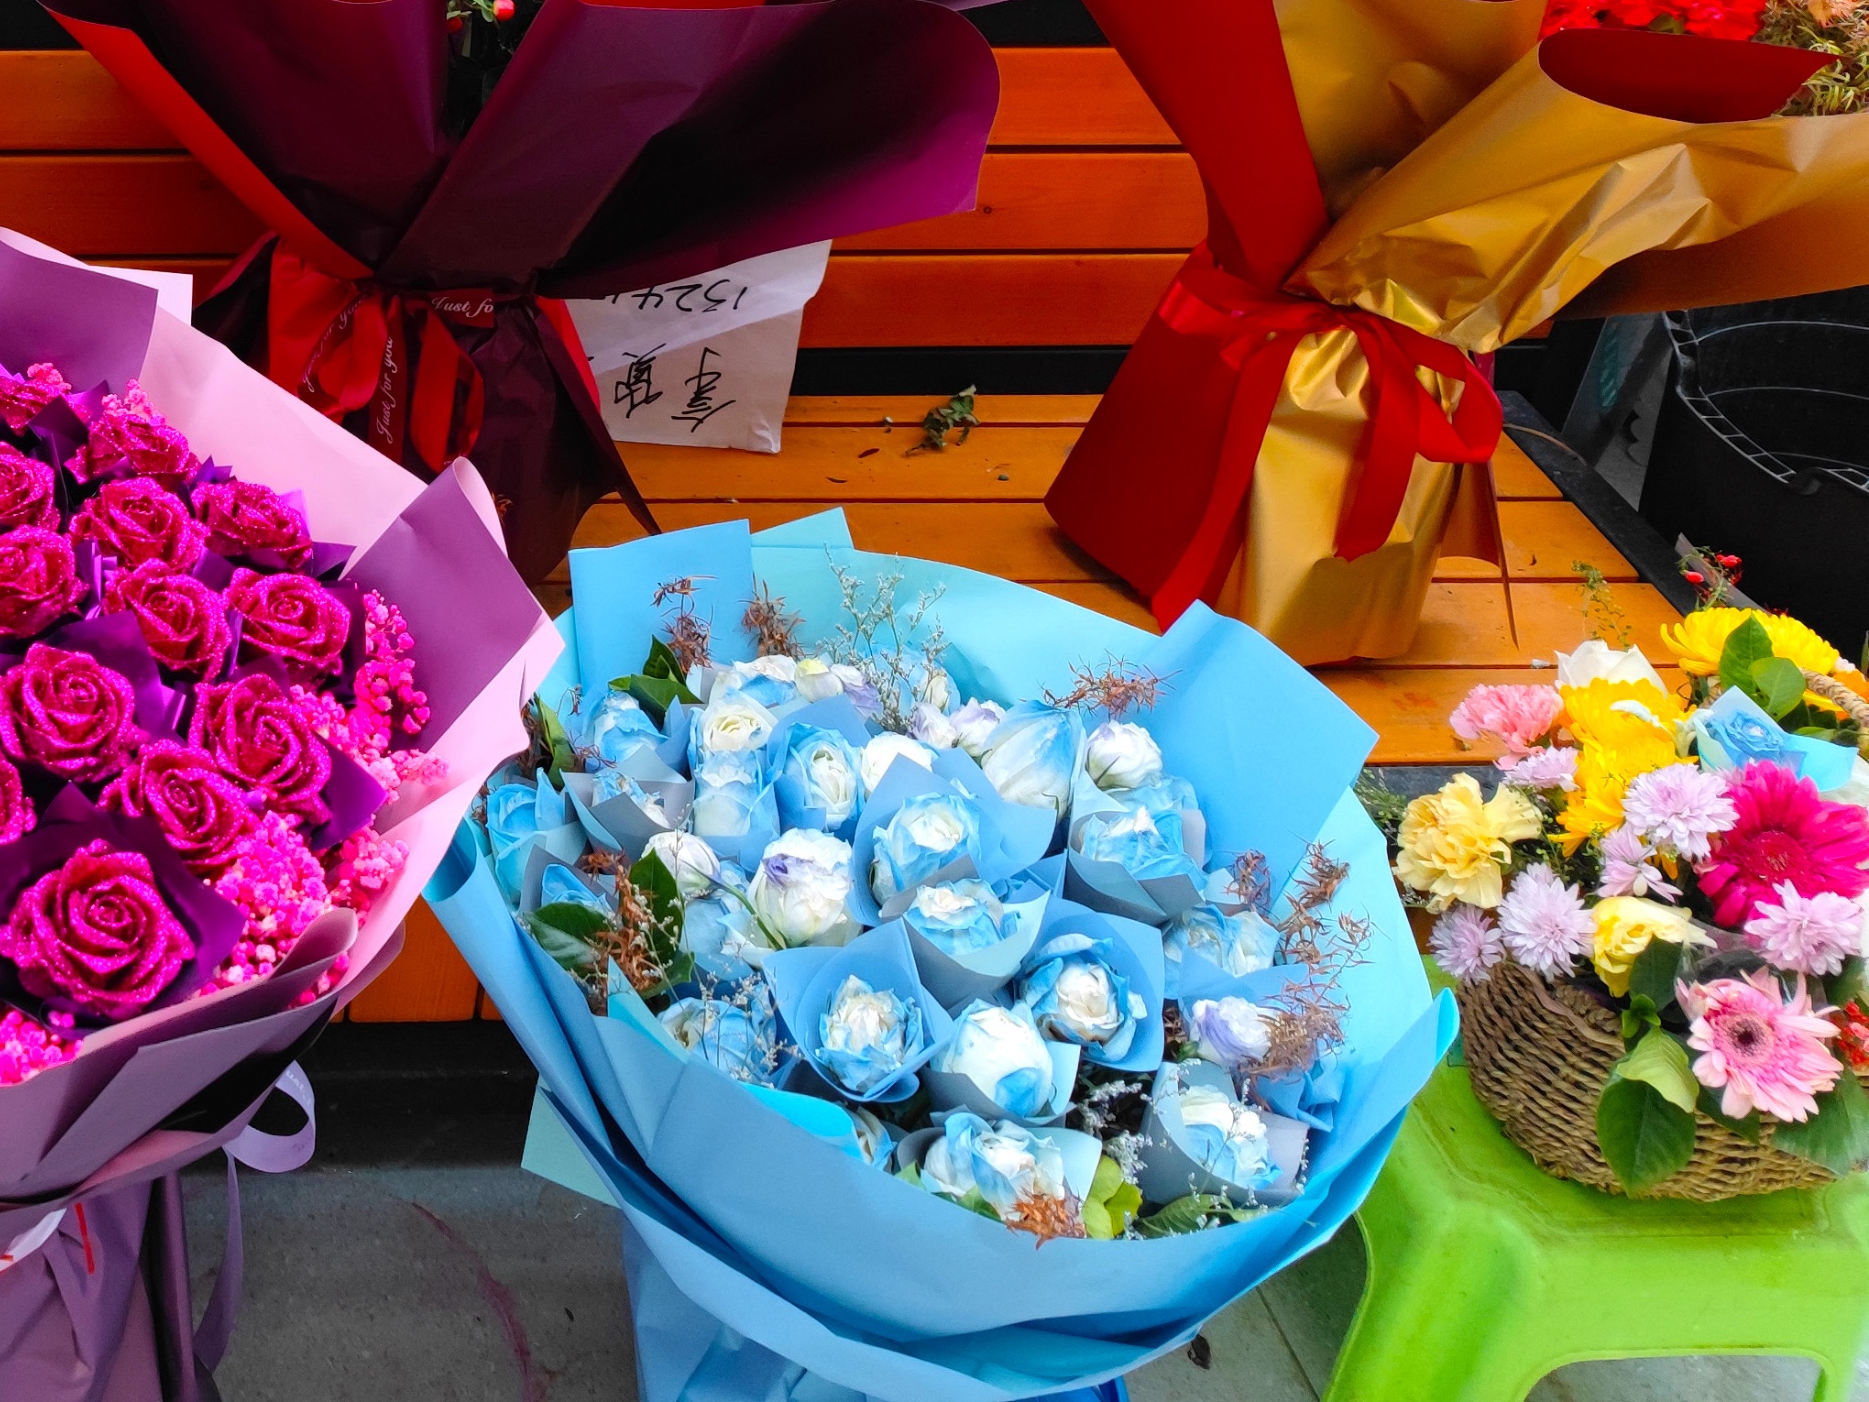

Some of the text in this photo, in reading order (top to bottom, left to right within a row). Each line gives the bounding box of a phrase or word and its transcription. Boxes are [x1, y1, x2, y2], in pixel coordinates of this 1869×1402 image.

[376, 336, 398, 445] Just for you
